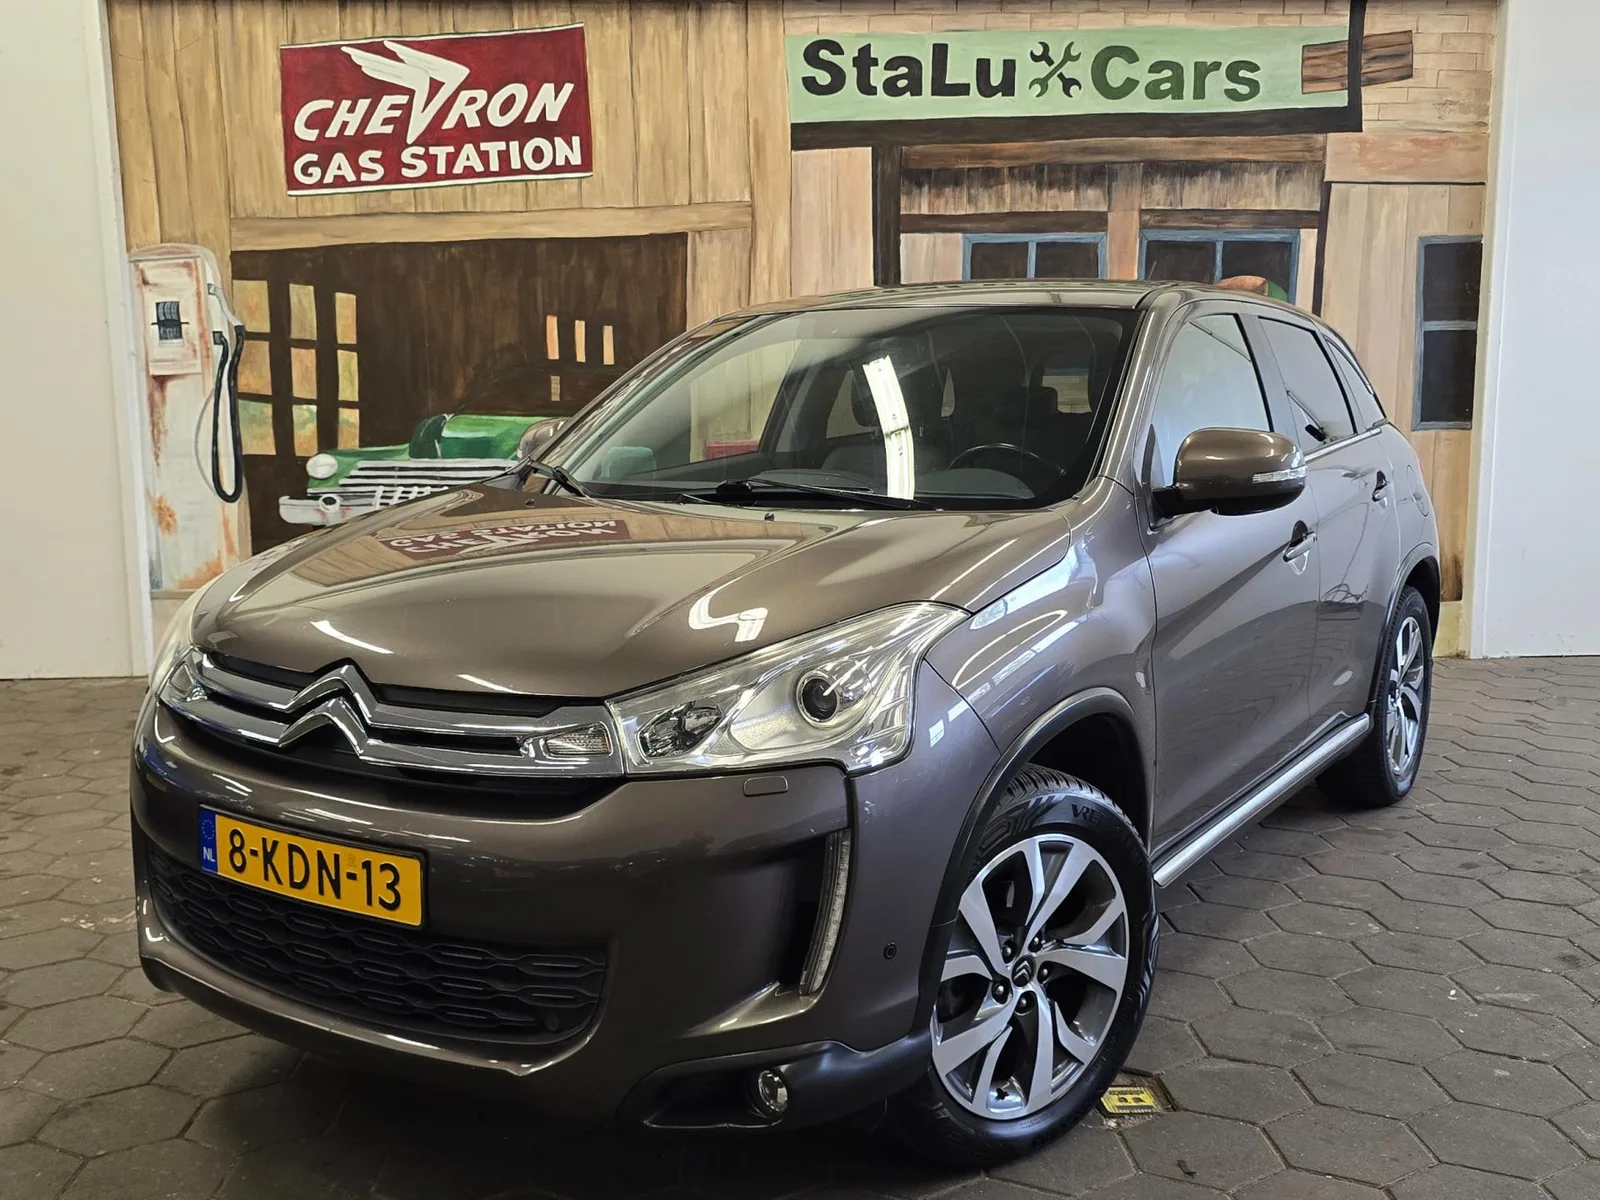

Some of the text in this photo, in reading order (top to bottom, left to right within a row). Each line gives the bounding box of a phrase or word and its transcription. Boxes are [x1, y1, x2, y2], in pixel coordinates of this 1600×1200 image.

[801, 39, 1262, 102] StaLu Cars
[293, 82, 575, 145] CHEVRON
[293, 136, 582, 185] GAS STATION
[203, 846, 216, 863] NL
[229, 828, 402, 912] 8-KDN-13
